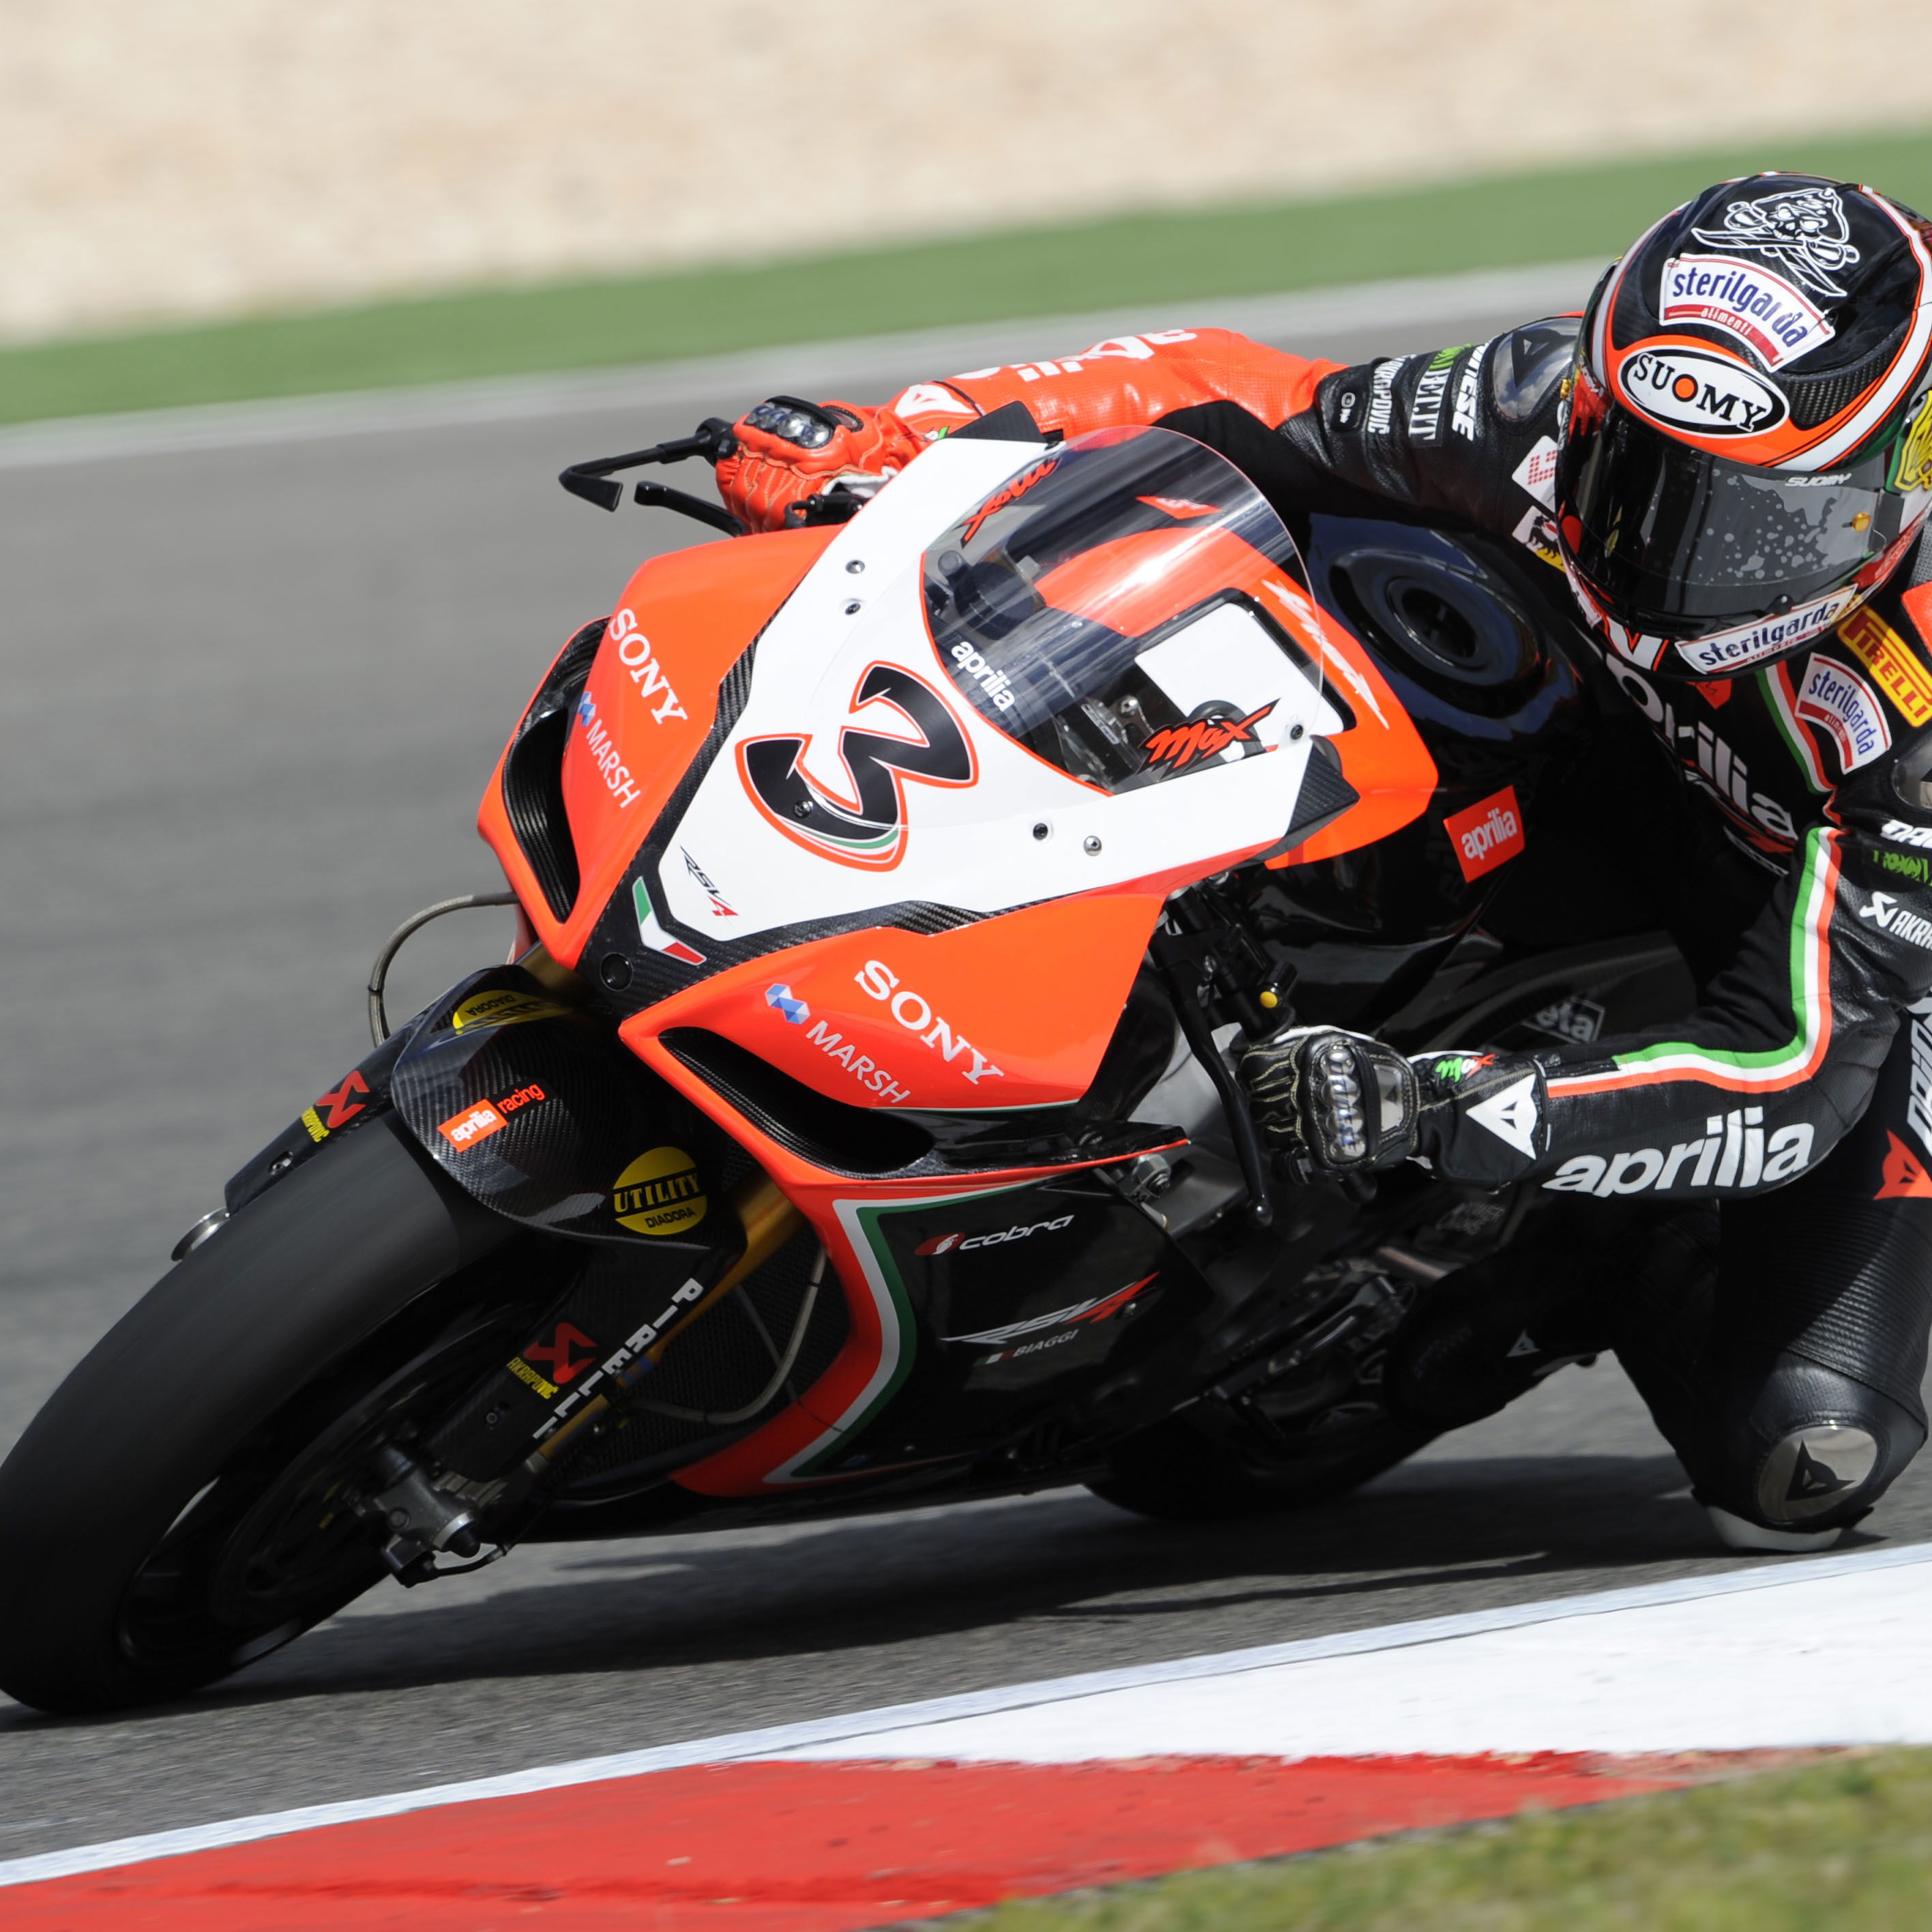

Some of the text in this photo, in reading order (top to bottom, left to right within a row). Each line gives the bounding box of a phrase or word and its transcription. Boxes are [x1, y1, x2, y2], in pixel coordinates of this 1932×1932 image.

[1673, 267, 1809, 348] sterilgarda
[1701, 307, 1754, 336] alimenti
[1634, 353, 1768, 430] SUOMY
[1785, 472, 1852, 486] SUOMY
[609, 608, 688, 725] SONY
[1699, 602, 1839, 667] sterilgarda
[1843, 611, 1932, 719] PIRELLI
[950, 641, 1016, 712] aprilia
[1808, 670, 1877, 755] sterilgarda
[586, 718, 641, 808] MARSH
[737, 662, 977, 870] 3
[1461, 807, 1518, 860] aprilia
[465, 994, 517, 1016] DIADORA
[853, 960, 1004, 1085] SONY
[806, 1020, 911, 1104] MARSH
[450, 1082, 546, 1142] aprilia racing
[1541, 1106, 1815, 1198] aprilia
[614, 1171, 701, 1213] UTILITY
[645, 1207, 697, 1229] DIADORA
[959, 1214, 1075, 1250] cobra
[533, 1277, 704, 1439] PIRELLI
[1013, 1329, 1079, 1358] BIAGGI
